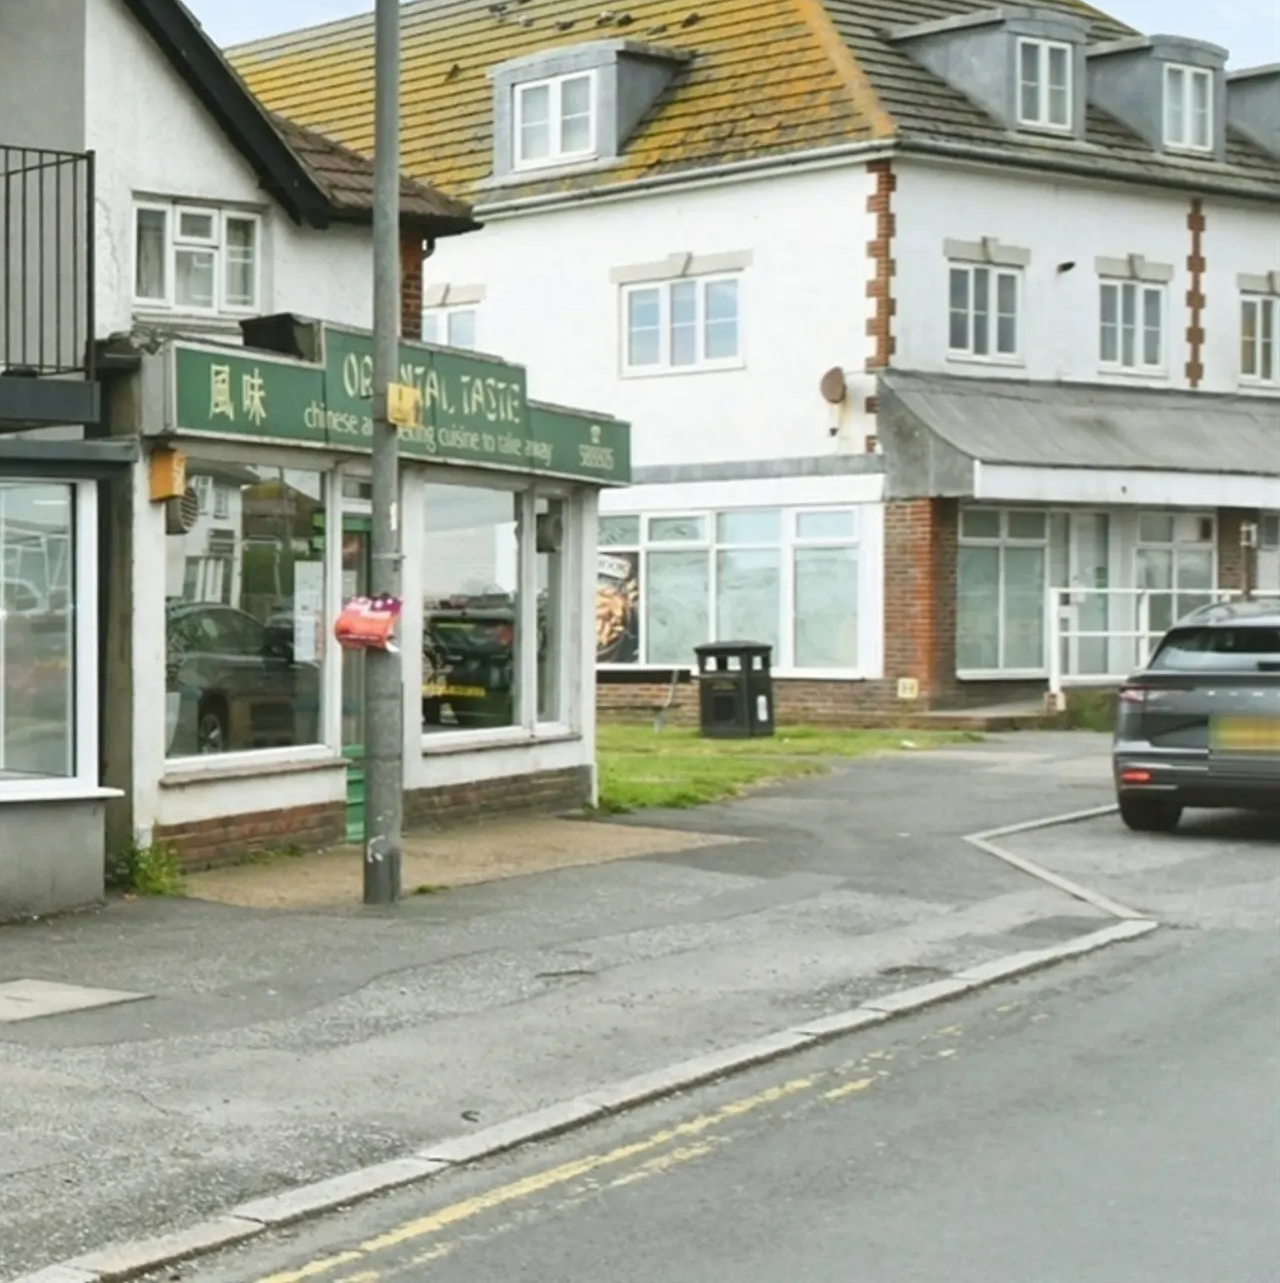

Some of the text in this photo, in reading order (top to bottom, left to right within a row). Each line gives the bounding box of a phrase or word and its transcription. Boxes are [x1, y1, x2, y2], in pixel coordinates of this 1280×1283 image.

[208, 363, 267, 427] 風味
[343, 352, 521, 424] ORNTAL TASTE
[303, 399, 358, 435] chinese
[439, 424, 481, 452] cuisine
[482, 431, 495, 453] to
[523, 437, 554, 467] away
